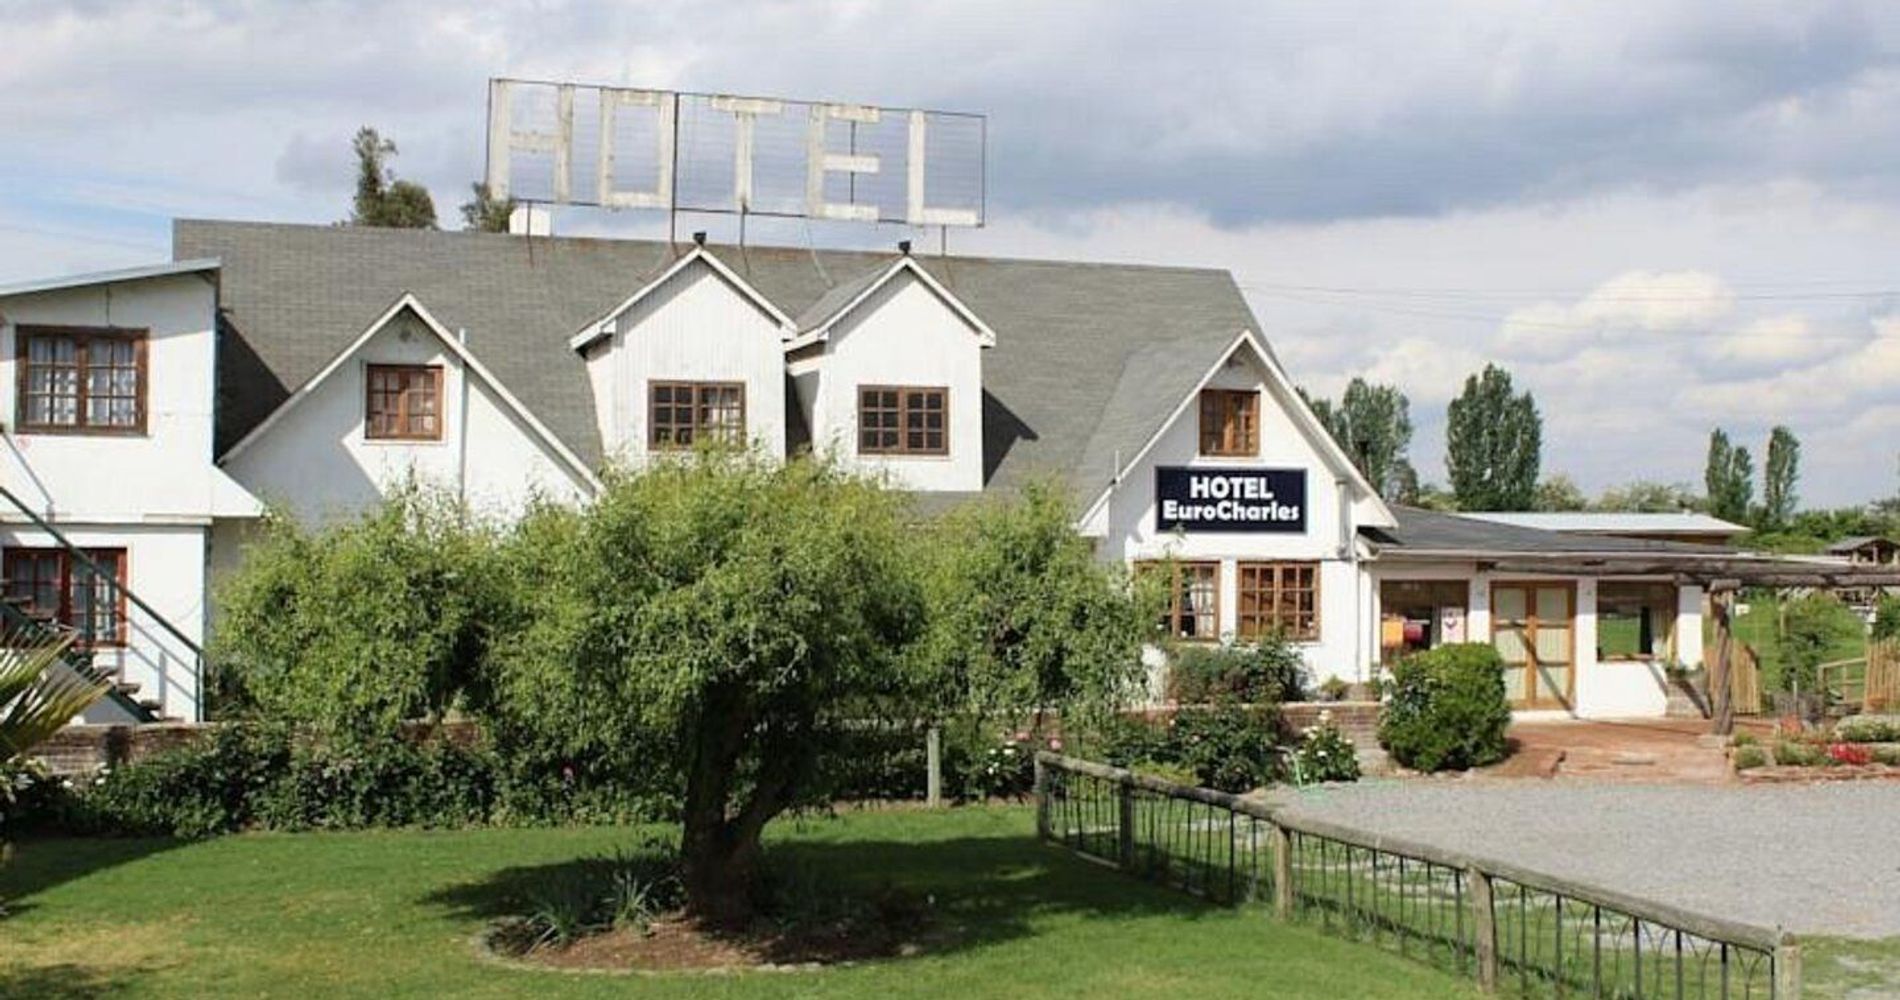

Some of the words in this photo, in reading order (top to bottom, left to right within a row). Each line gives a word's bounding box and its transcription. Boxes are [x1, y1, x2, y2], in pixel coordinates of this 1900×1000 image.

[488, 79, 980, 226] HOTEL
[1190, 476, 1274, 499] HOTEL
[1163, 500, 1299, 521] EuroCharles
